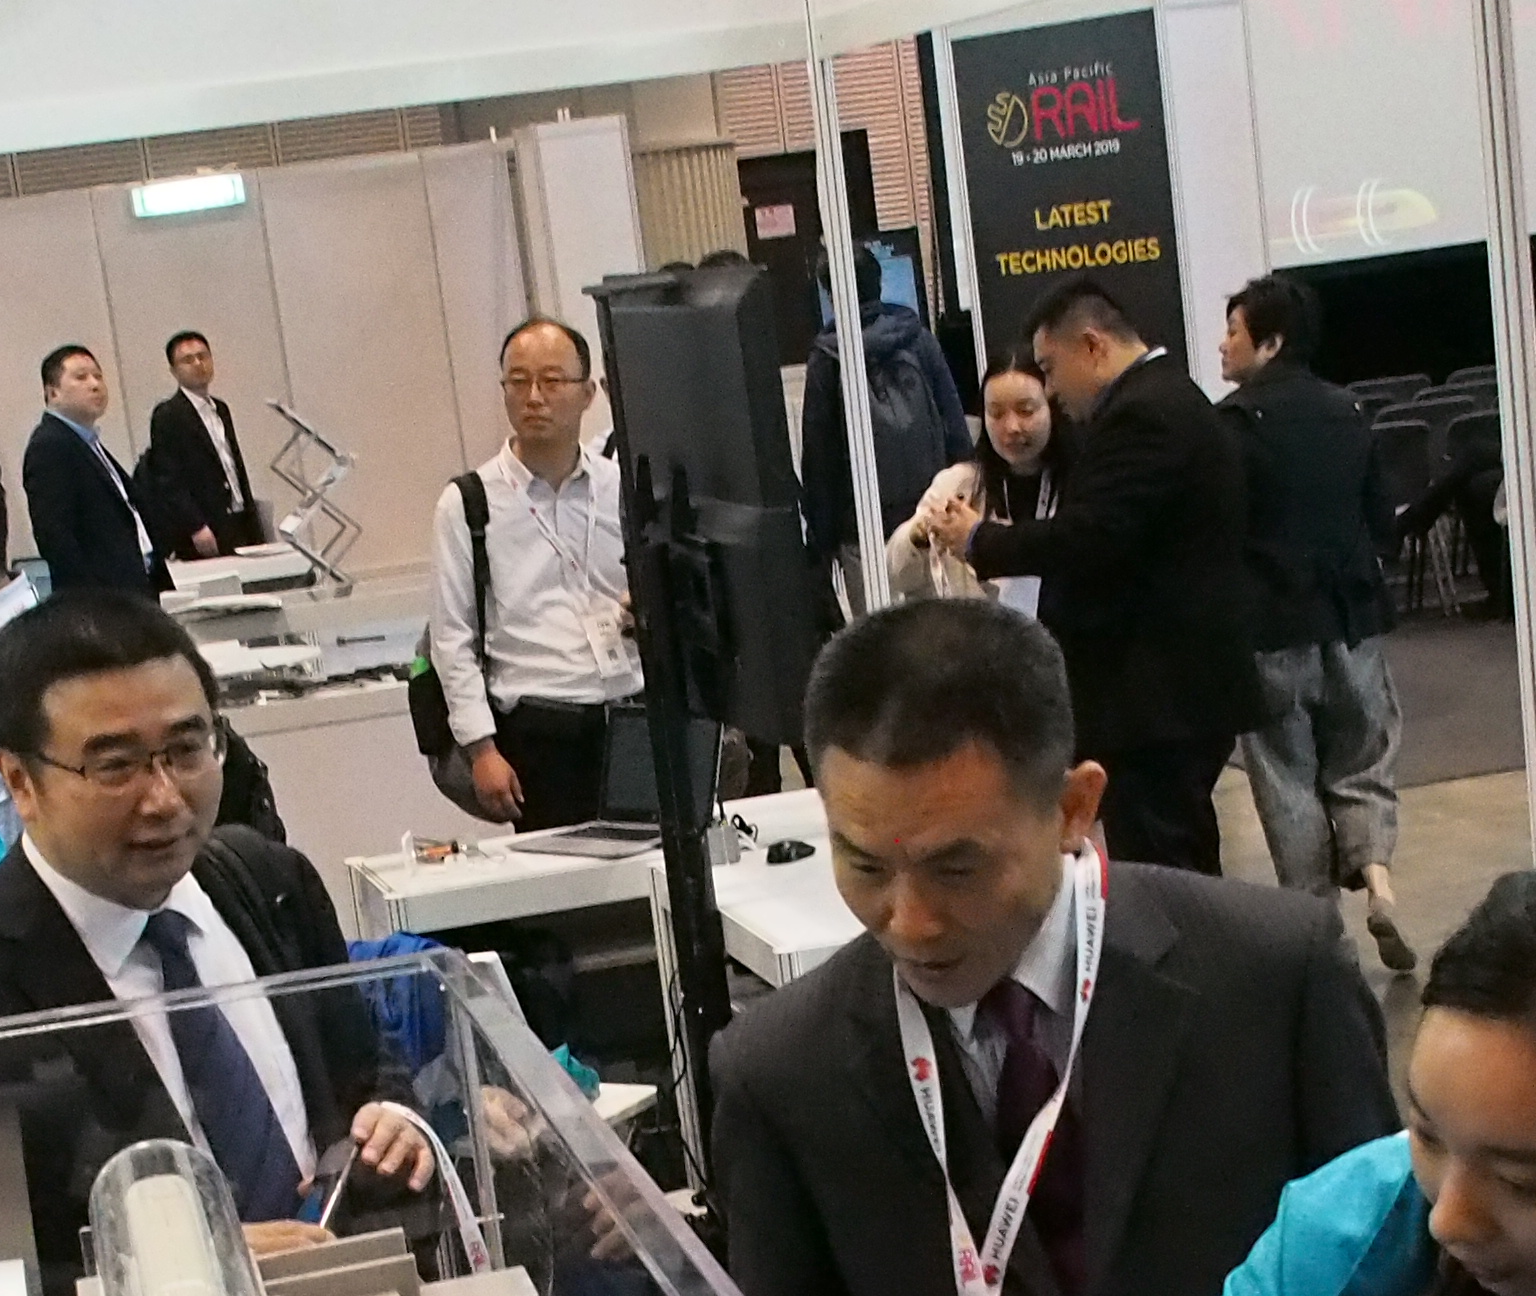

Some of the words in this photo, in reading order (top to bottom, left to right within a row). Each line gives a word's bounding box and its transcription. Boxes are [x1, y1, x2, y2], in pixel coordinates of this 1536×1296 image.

[1028, 72, 1058, 86] Asia
[1064, 60, 1114, 81] Pacific
[1031, 78, 1141, 140] RAIL
[1011, 151, 1025, 166] 19
[1033, 148, 1048, 164] 20
[1050, 142, 1092, 162] MARCH
[1094, 138, 1121, 156] 2019
[1034, 200, 1112, 231] LATEST
[996, 236, 1161, 277] TECHNOLOGIES
[991, 1196, 1021, 1261] HUAWEI
